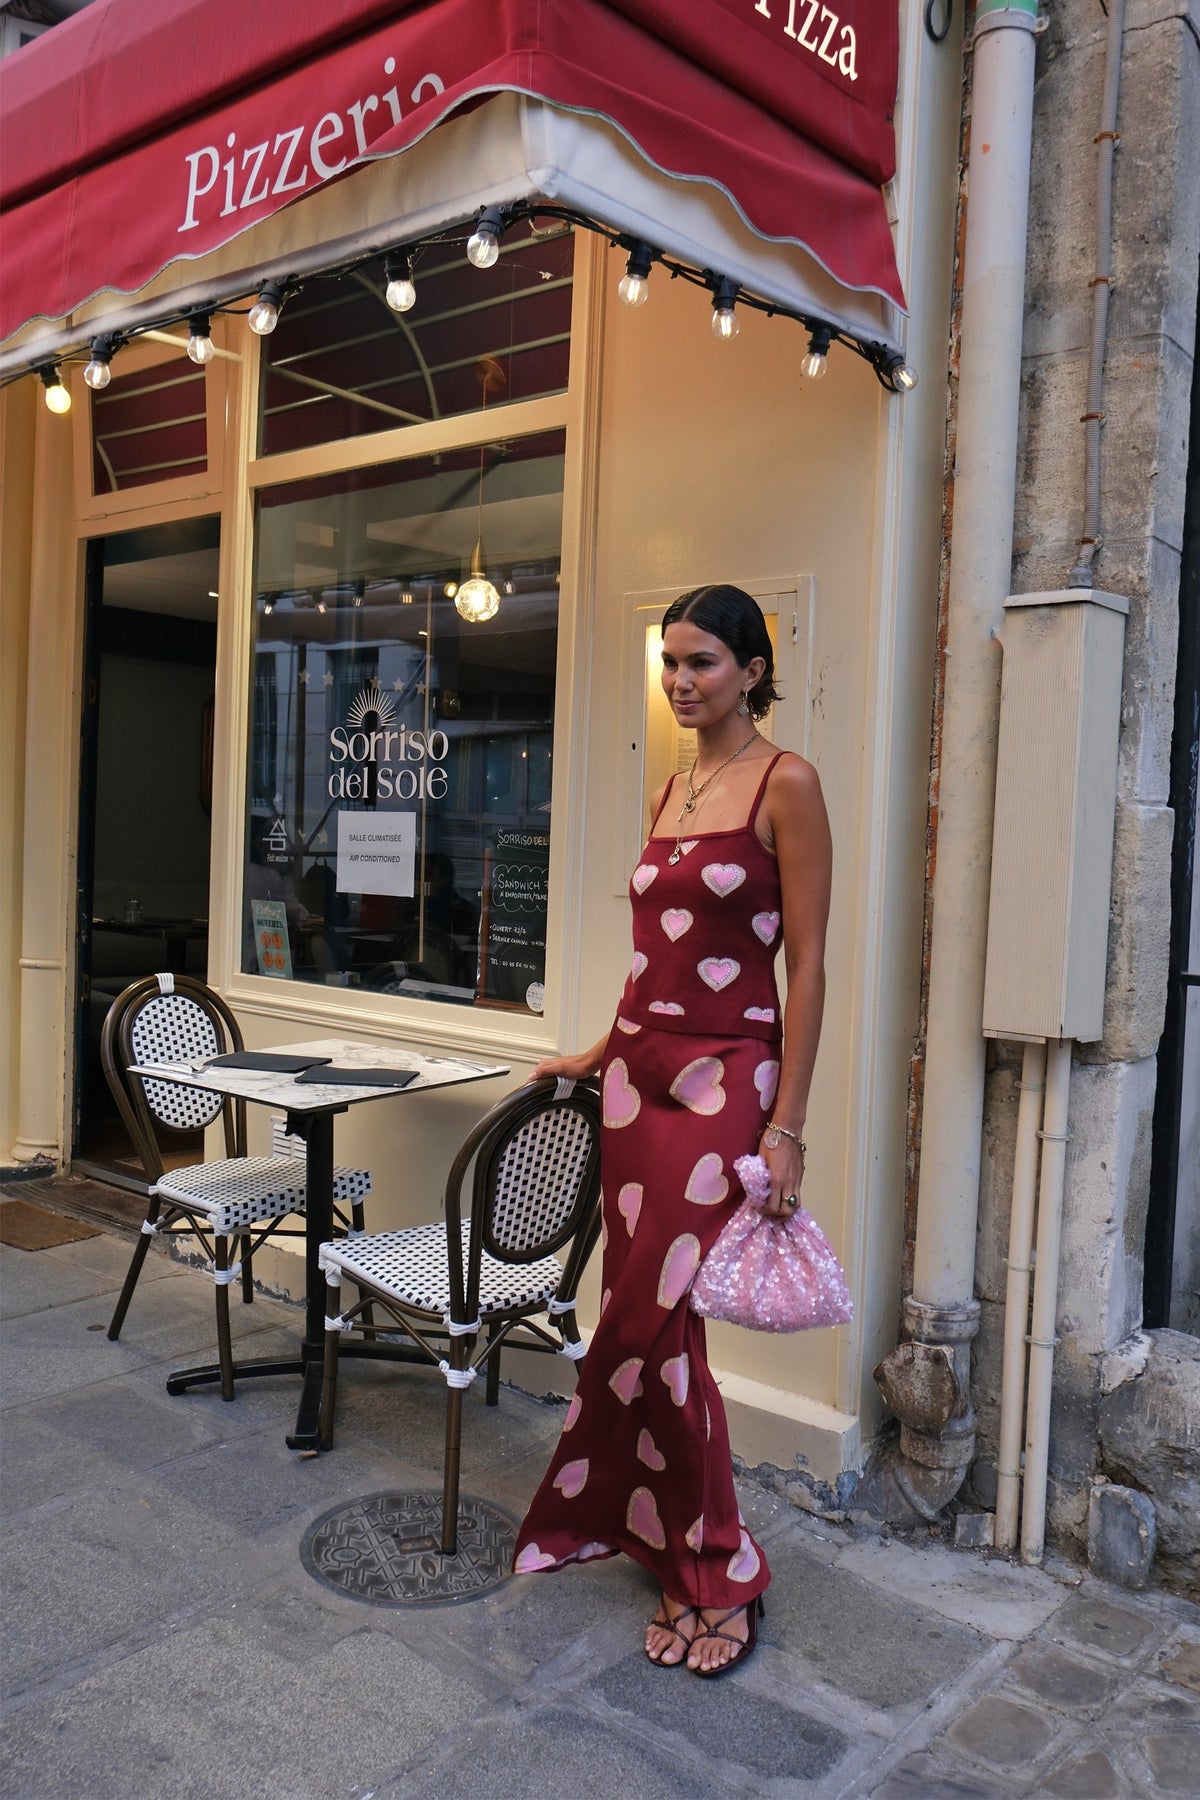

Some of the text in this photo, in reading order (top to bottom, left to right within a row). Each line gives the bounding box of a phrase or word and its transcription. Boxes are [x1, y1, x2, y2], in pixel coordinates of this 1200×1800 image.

[754, 0, 858, 81] izza
[329, 723, 449, 762] Sorriso
[328, 767, 369, 799] del
[348, 832, 402, 842] SALLE CLIMATISÉE
[533, 836, 548, 846] DEL
[349, 854, 401, 863] AIR CONDITIONED
